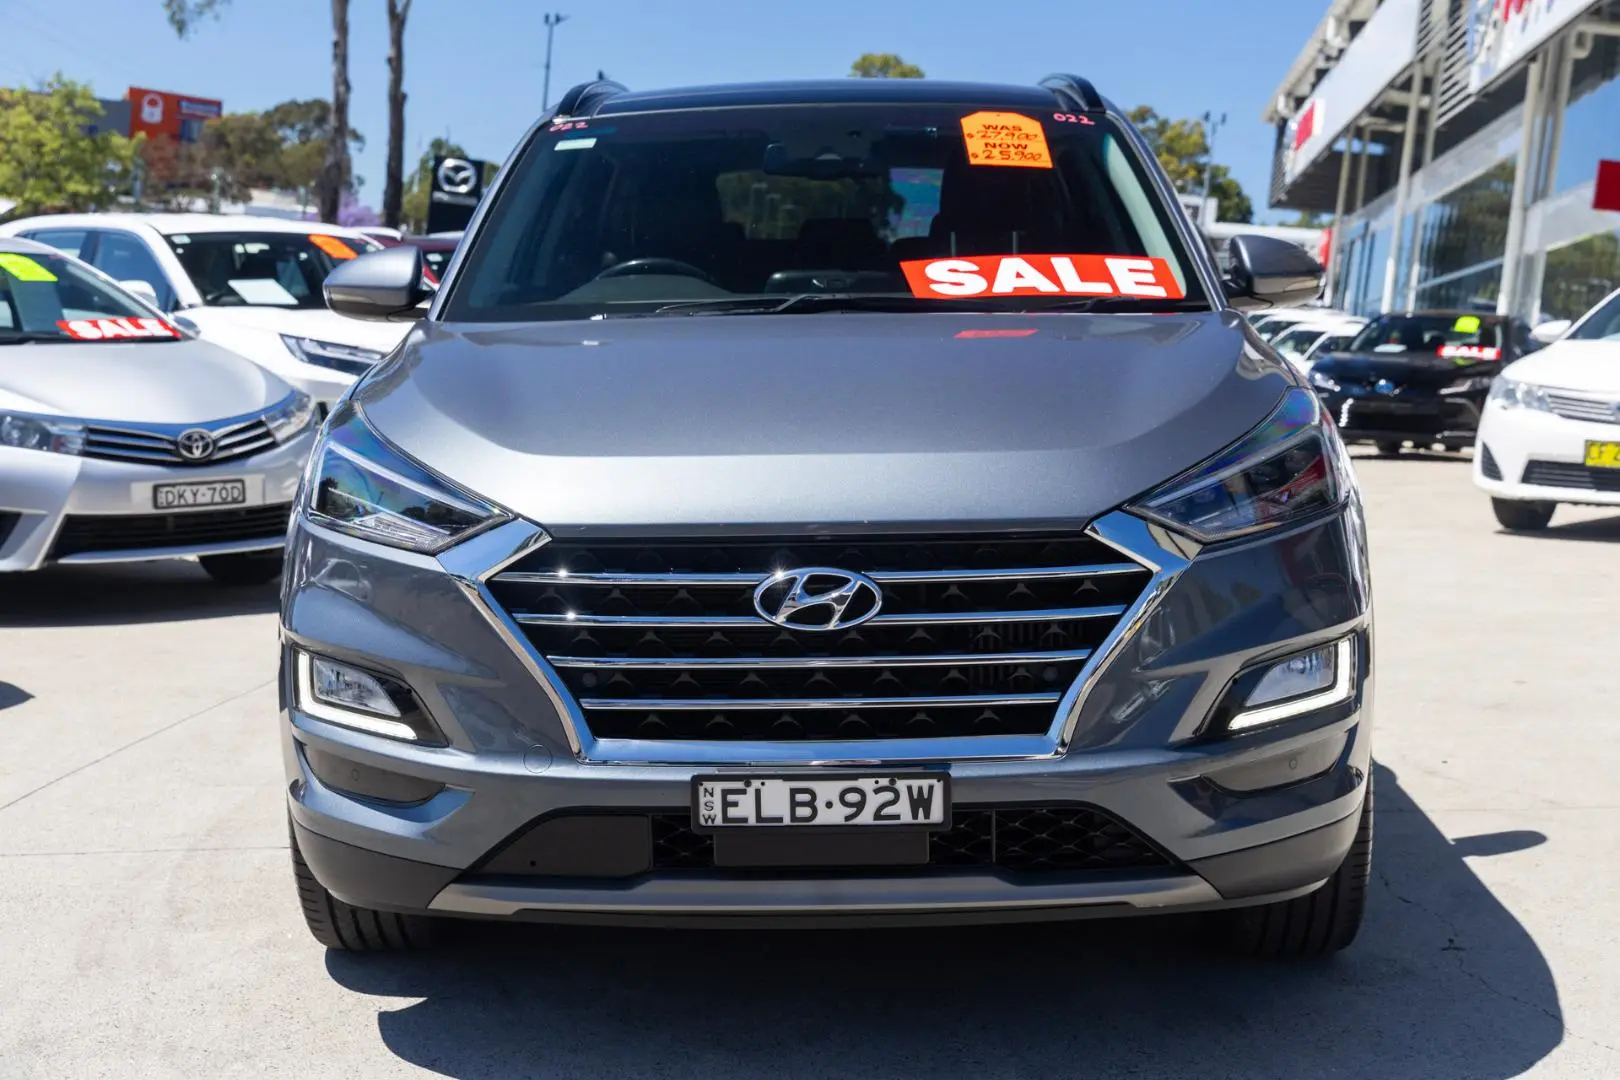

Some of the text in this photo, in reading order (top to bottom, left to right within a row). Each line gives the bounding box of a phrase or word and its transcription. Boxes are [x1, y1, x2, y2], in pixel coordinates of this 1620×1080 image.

[1053, 112, 1095, 125] 022
[982, 124, 1022, 132] WAS
[984, 142, 1028, 150] NOW
[924, 257, 1168, 298] SALE
[68, 319, 174, 339] SALE
